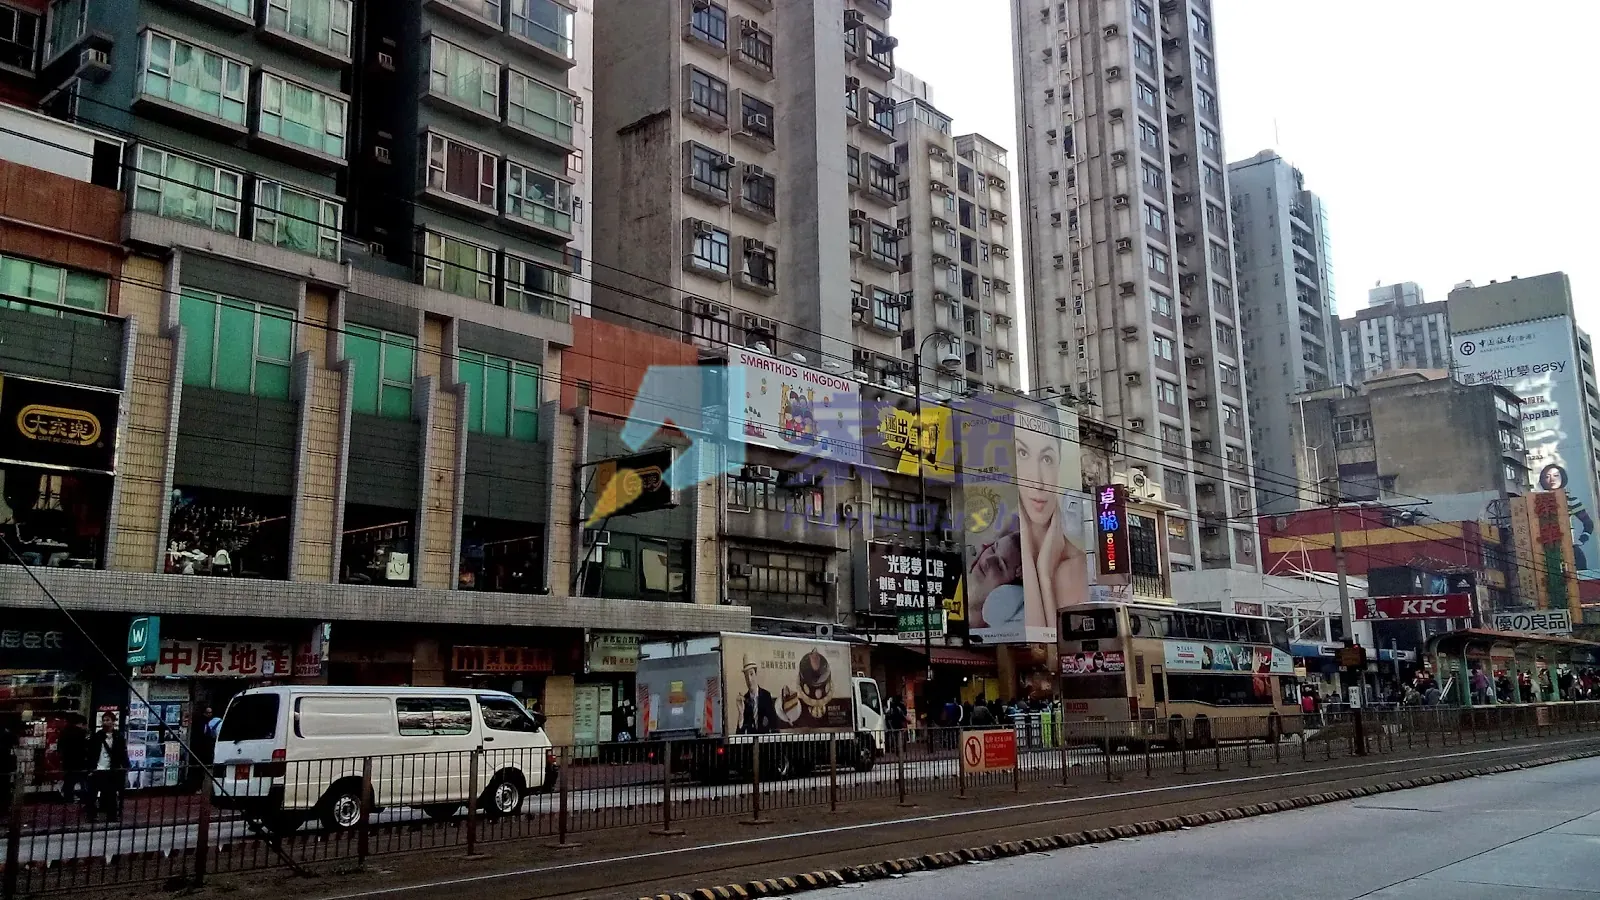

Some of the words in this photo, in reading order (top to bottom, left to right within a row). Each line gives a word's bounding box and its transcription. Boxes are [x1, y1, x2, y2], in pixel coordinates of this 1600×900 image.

[740, 353, 798, 378] SMARTKIDS
[803, 370, 850, 392] KINGDOM
[1532, 360, 1567, 374] easy
[1019, 414, 1050, 434] INGRID
[1522, 412, 1541, 422] App
[1100, 487, 1118, 531] 卓悅
[1106, 532, 1116, 571] BONJOUR
[1402, 599, 1448, 614] KFC
[1494, 612, 1567, 632] 優の良品
[132, 628, 144, 643] W
[159, 641, 289, 675] 中原地產
